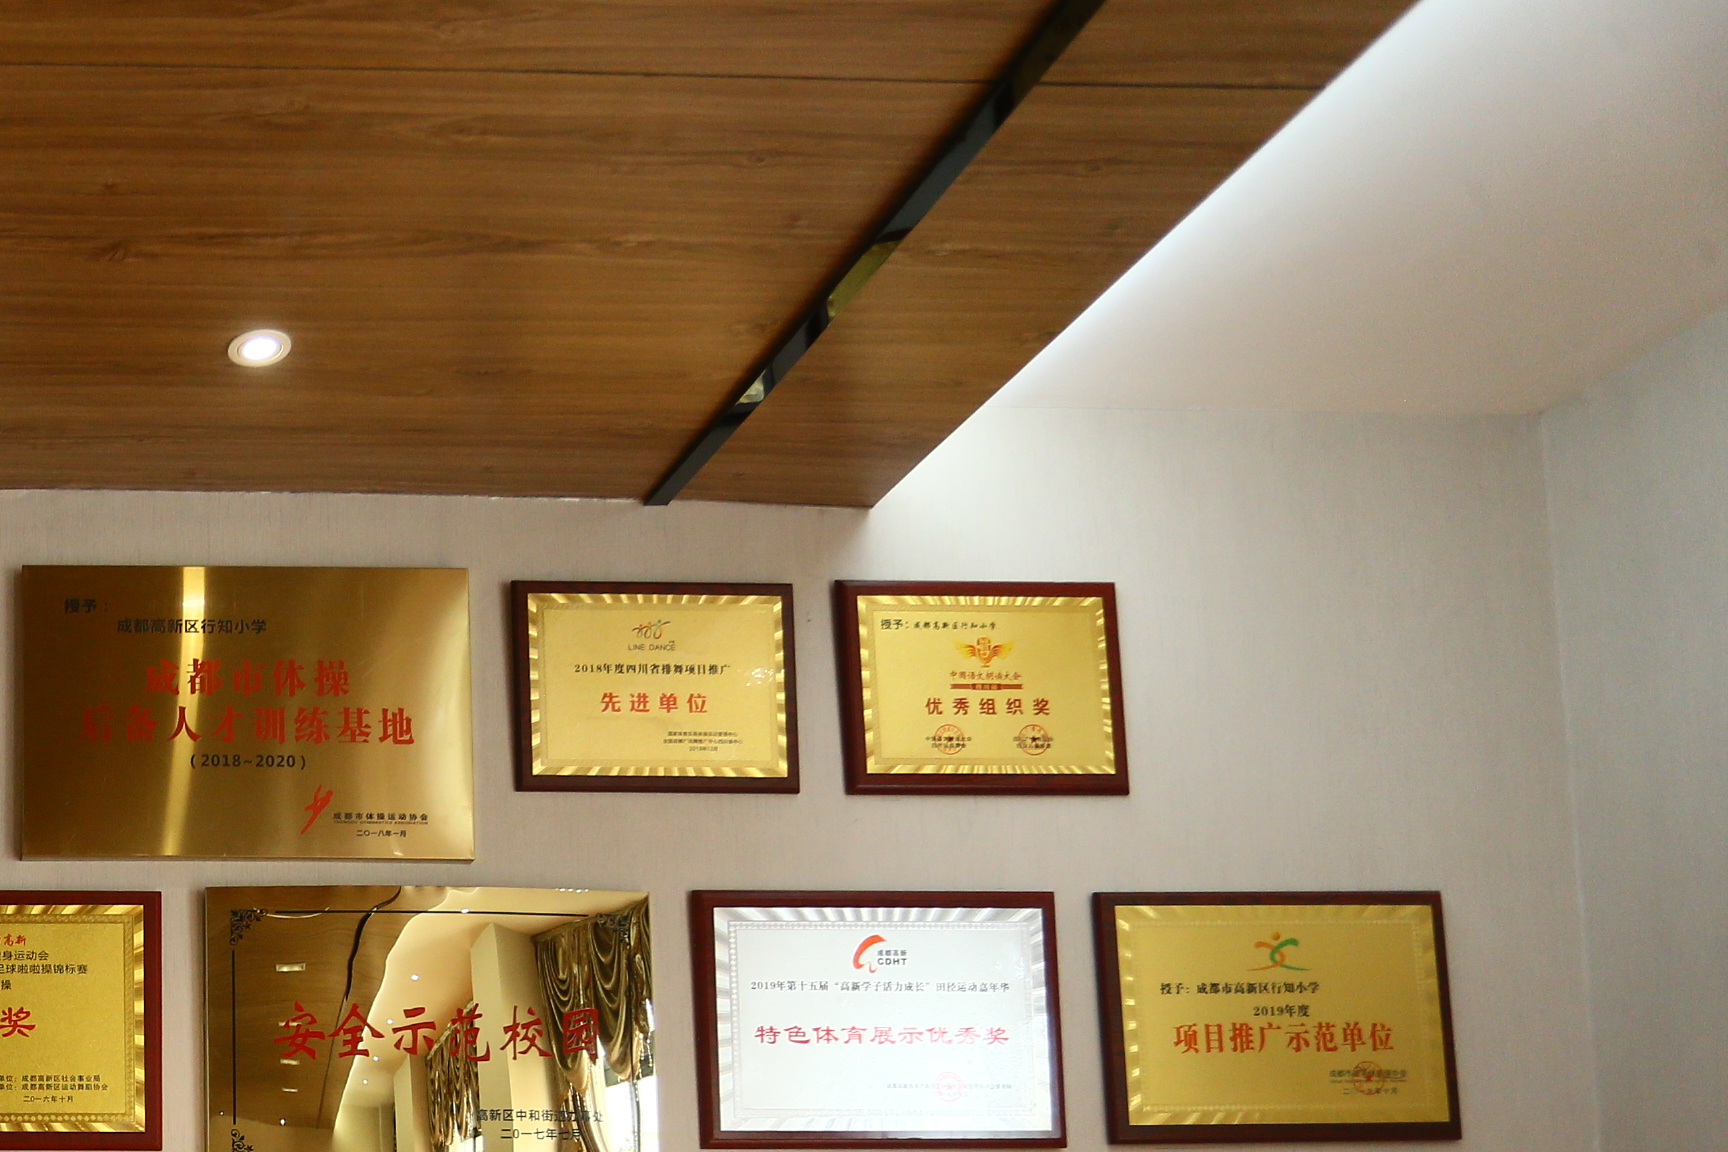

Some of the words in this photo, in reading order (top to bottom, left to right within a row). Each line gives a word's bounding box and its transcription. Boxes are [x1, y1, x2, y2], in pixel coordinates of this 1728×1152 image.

[117, 618, 268, 635] 成都高新区行知小学
[628, 643, 645, 651] LINE
[648, 643, 676, 651] DANCE
[145, 657, 351, 697] 成都市体操
[574, 662, 731, 675] 2018年度四川省排舞项目推广
[600, 692, 708, 714] 先进单位
[925, 697, 1051, 716] 优秀组织奖
[80, 703, 416, 745] 后备人才训练基地
[333, 812, 429, 821] 成都市体操运动协会
[877, 949, 908, 957] 成都高新
[877, 957, 908, 966] CDHT
[1253, 1004, 1311, 1018] 2019年度
[272, 1000, 600, 1062] 安全示范校园
[754, 1025, 1011, 1046] 特色体育展示优秀奖
[1173, 1021, 1395, 1054] 项目推广示范单位
